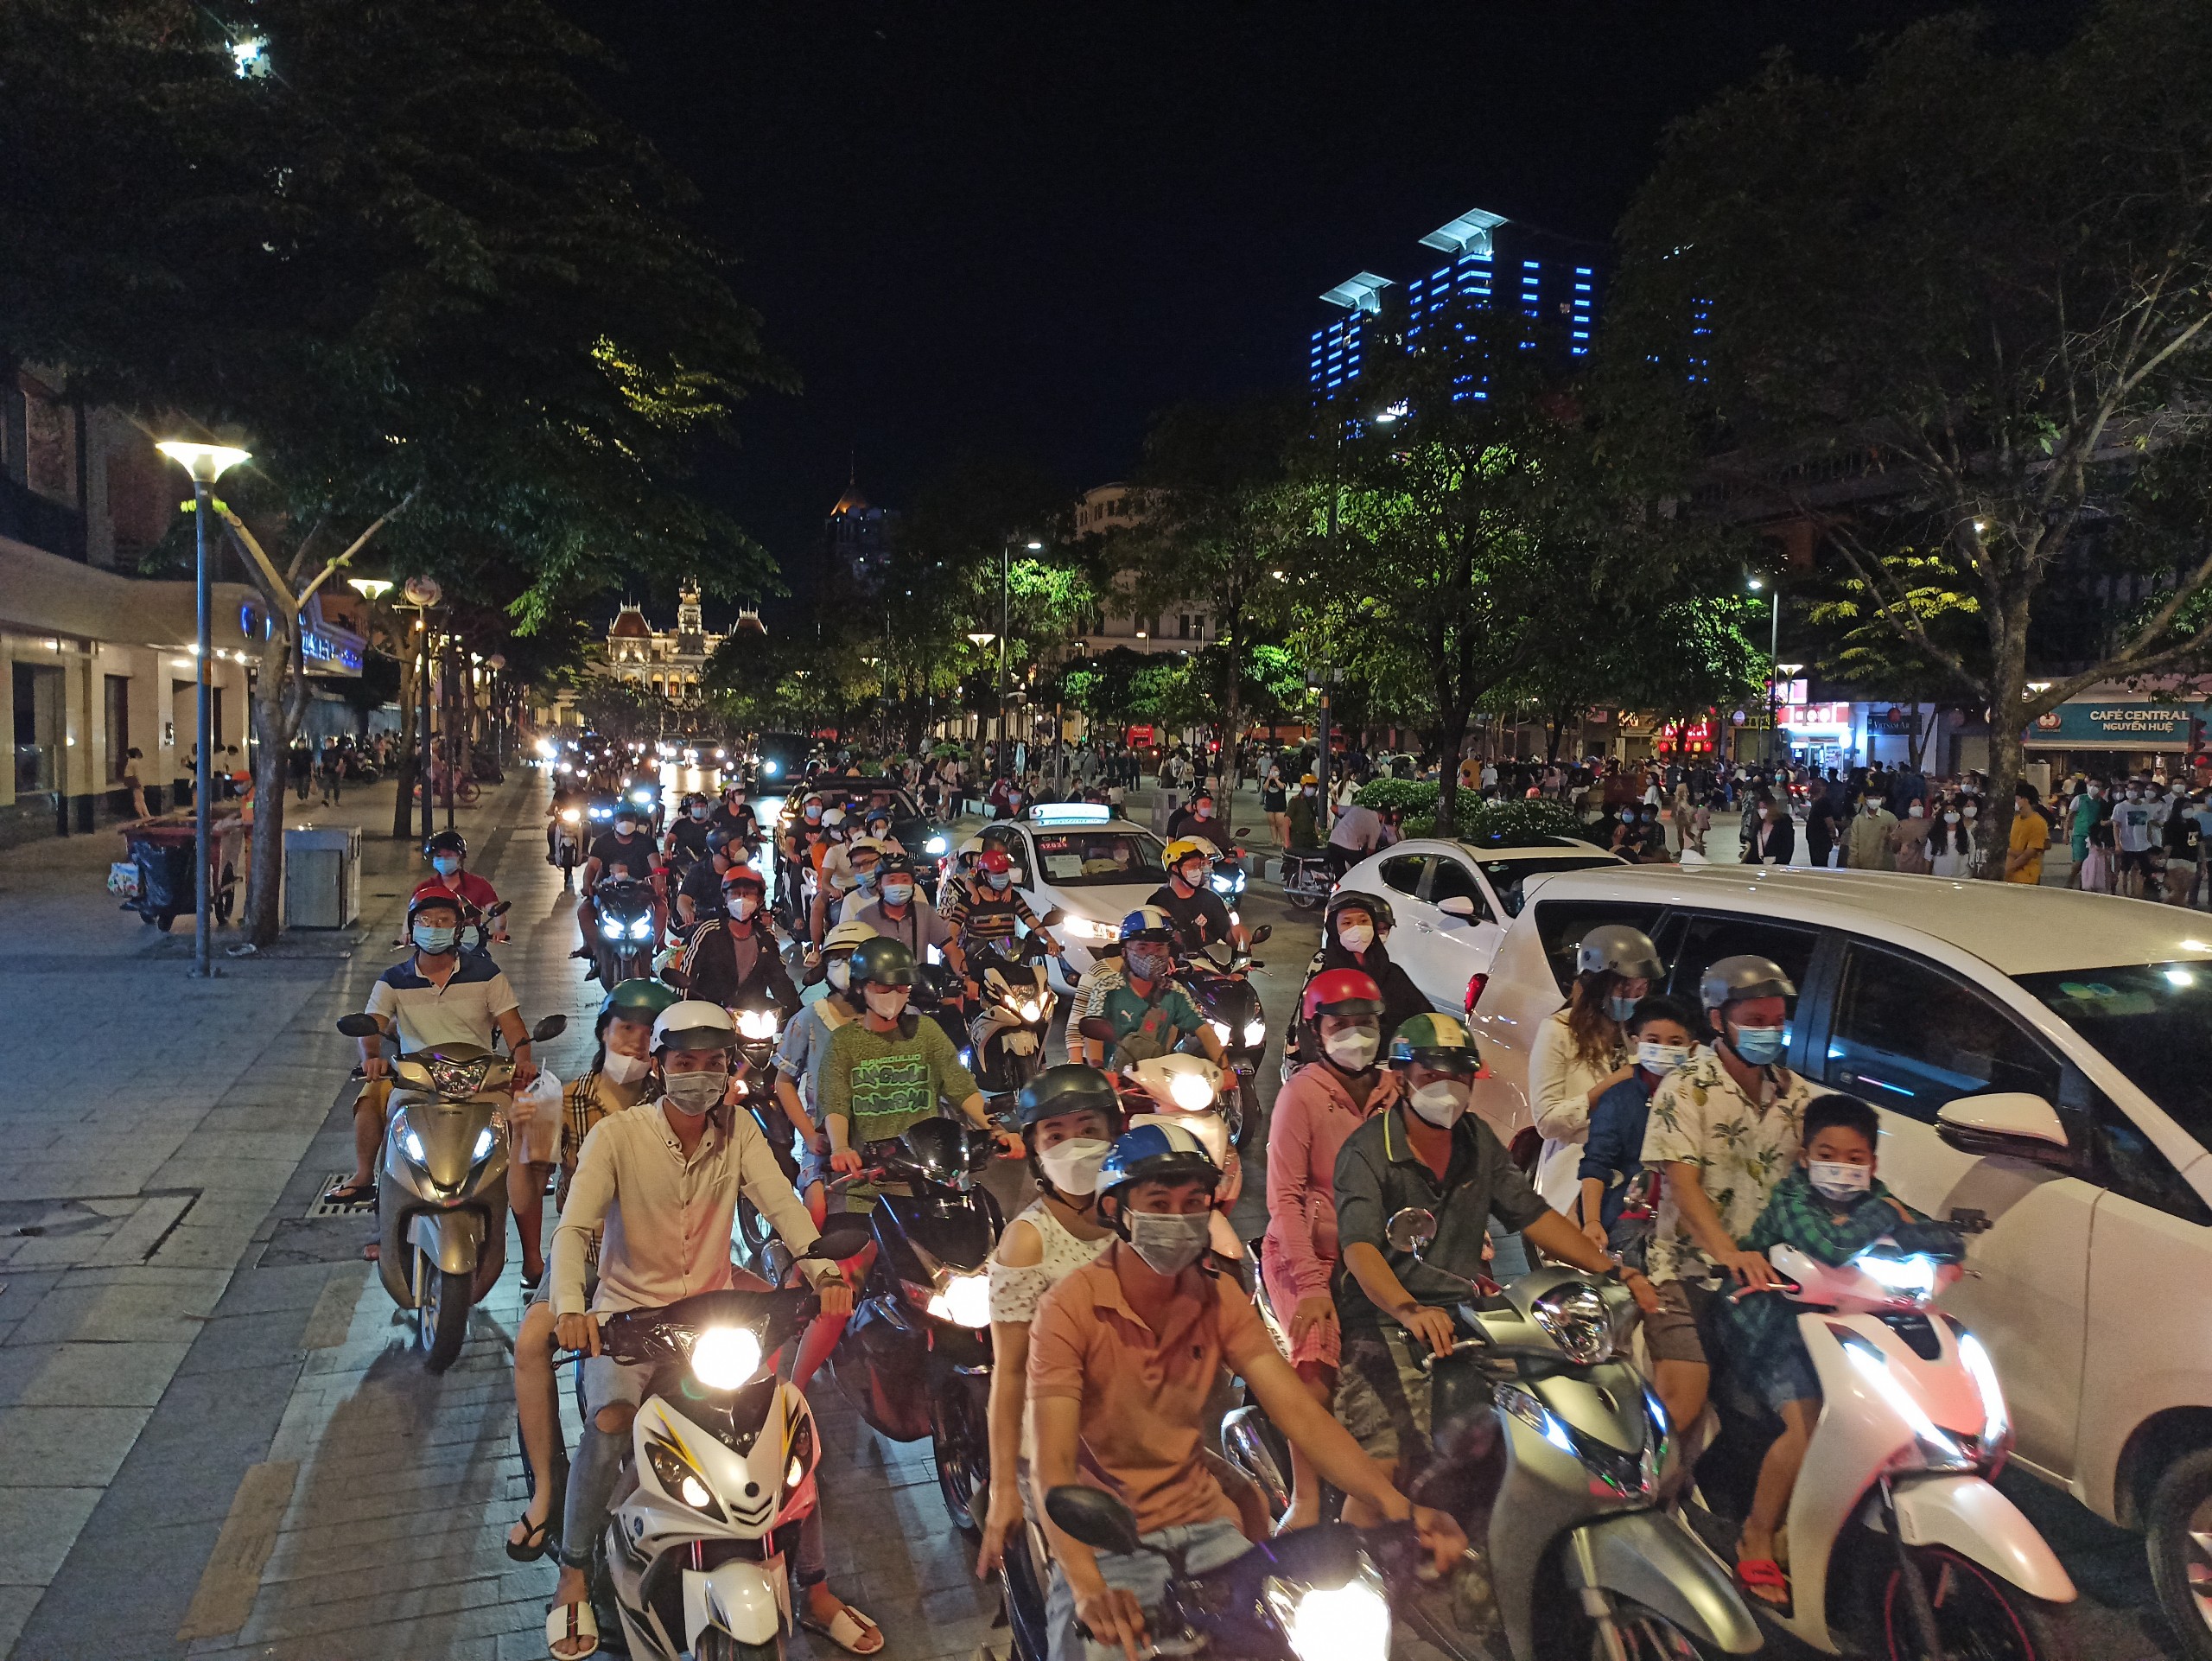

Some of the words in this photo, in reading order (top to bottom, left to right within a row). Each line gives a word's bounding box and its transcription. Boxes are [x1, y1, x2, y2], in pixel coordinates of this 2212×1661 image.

[2089, 709, 2124, 721] CAFÉ
[2125, 710, 2190, 721] CENTRAL
[2148, 722, 2174, 734] HUỆ
